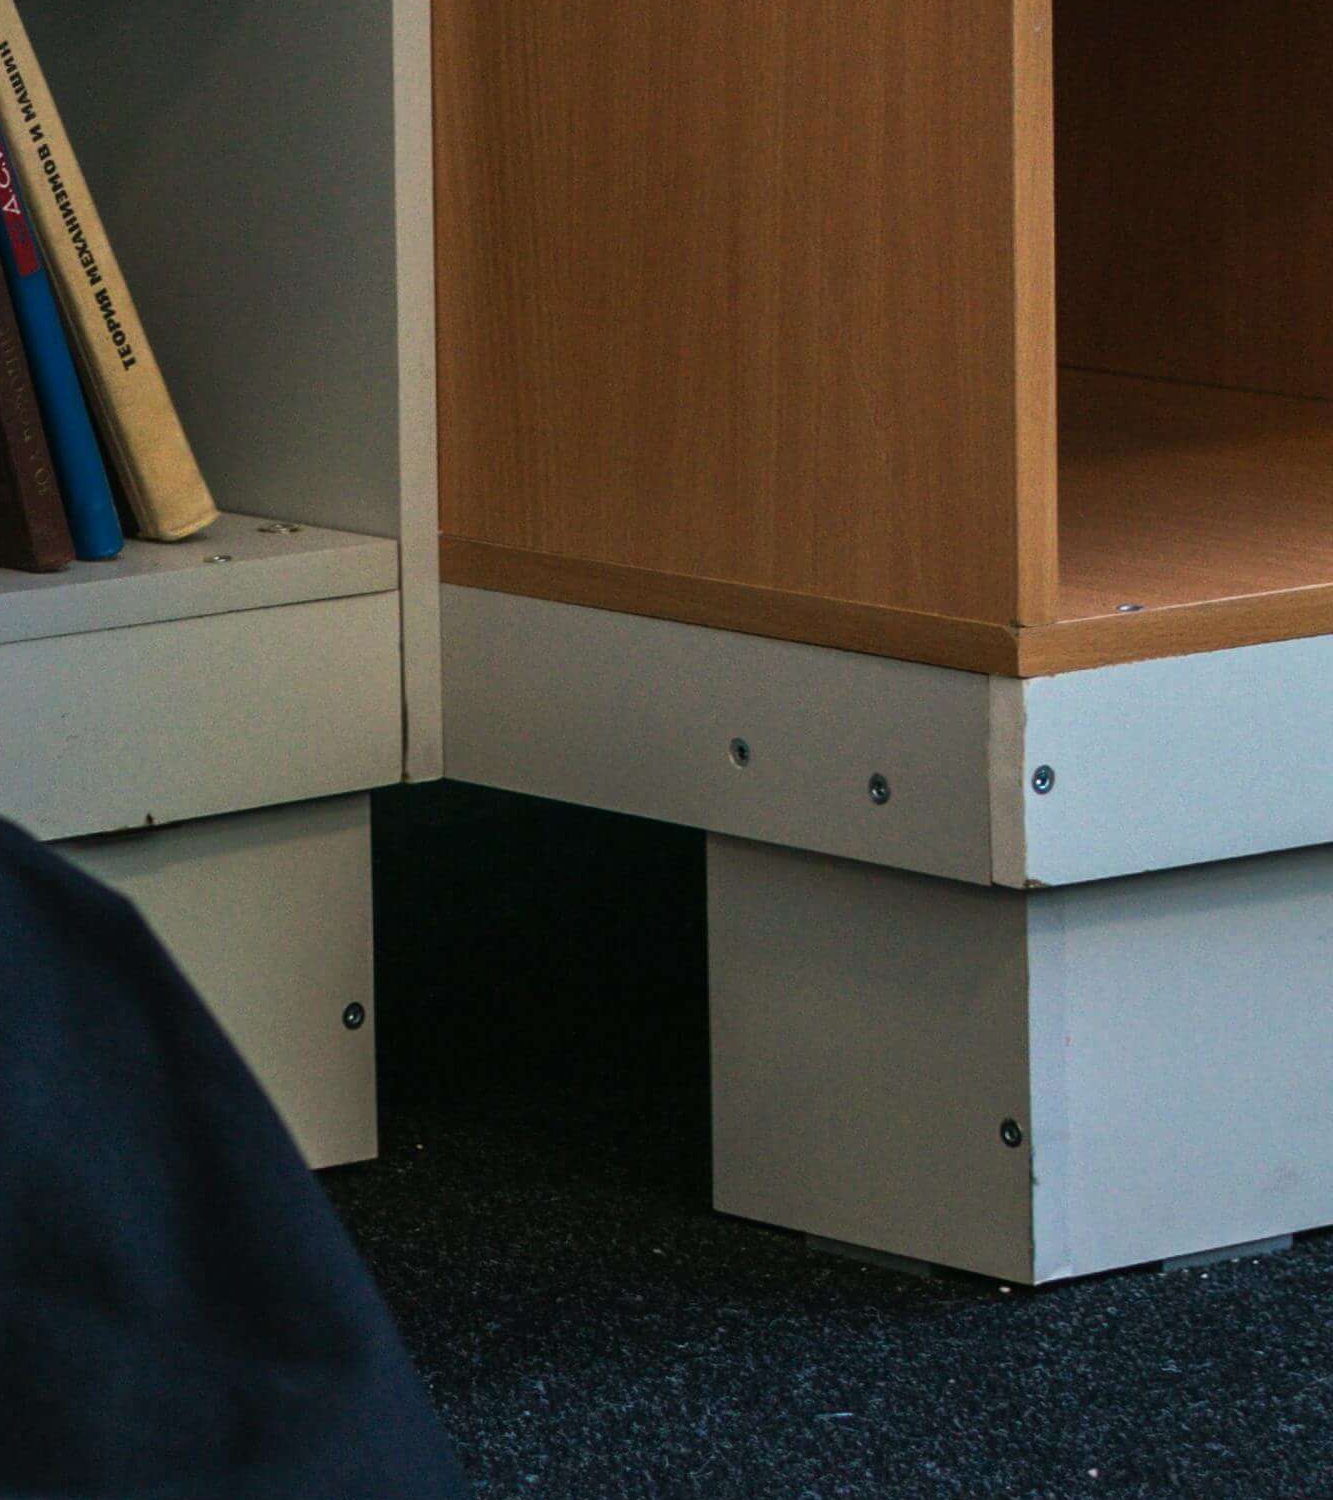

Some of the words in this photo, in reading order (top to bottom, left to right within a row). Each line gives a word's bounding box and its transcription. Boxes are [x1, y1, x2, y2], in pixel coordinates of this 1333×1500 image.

[28, 122, 46, 142] И
[35, 141, 104, 286] МЕХАНИЗМОВ
[93, 286, 139, 370] ТЕОРИЯ
